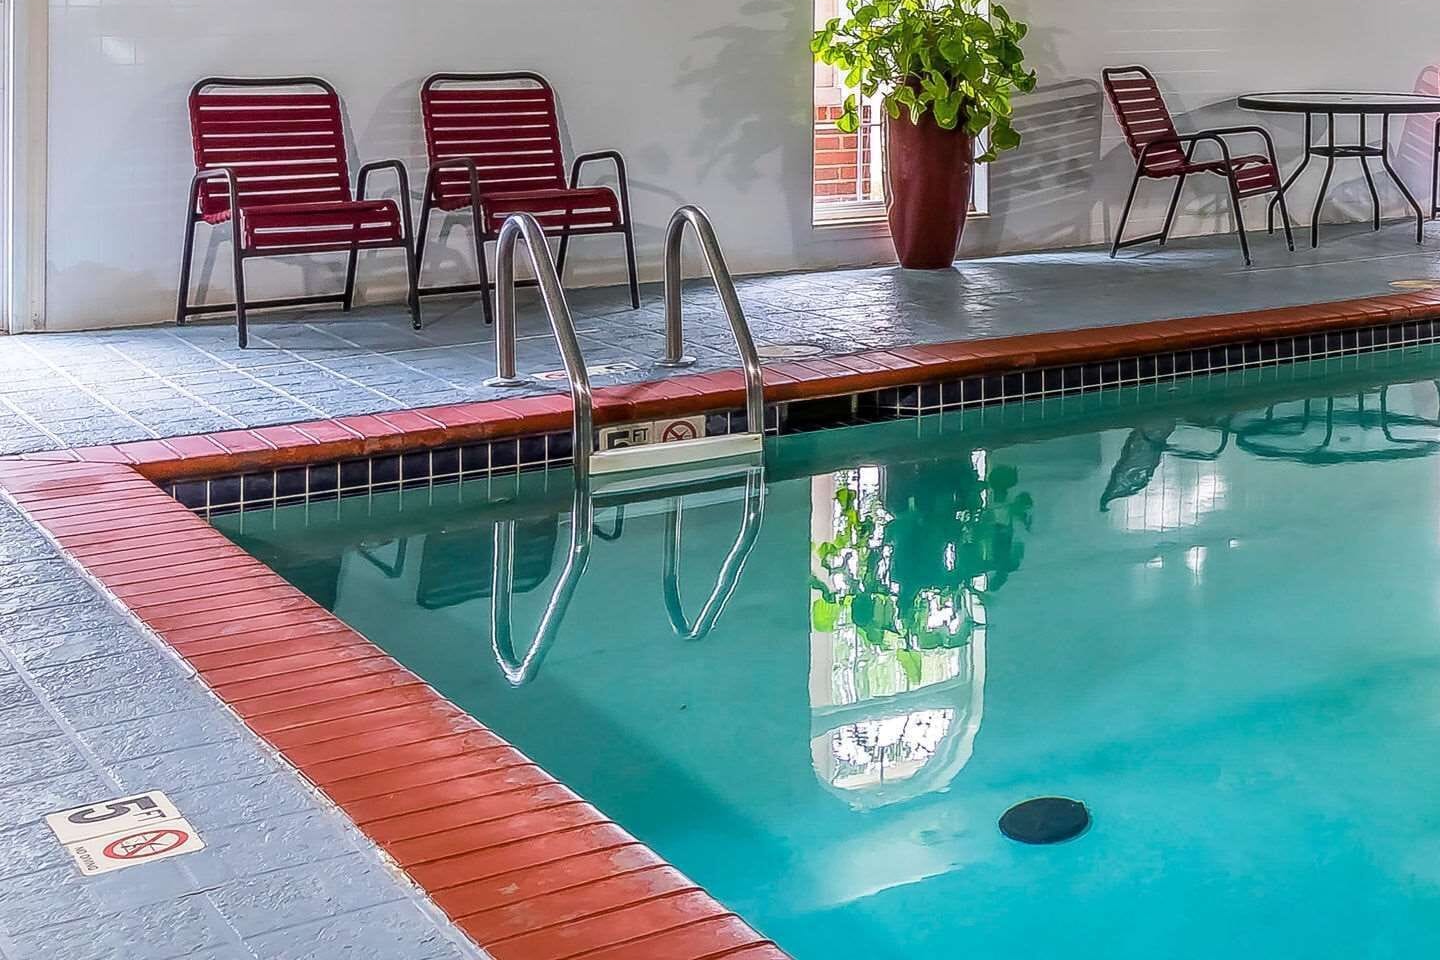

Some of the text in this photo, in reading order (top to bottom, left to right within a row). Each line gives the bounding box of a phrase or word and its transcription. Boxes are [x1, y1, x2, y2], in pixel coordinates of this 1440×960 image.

[632, 427, 649, 443] FT
[68, 795, 167, 824] 5 FT
[80, 854, 99, 871] DIVING
